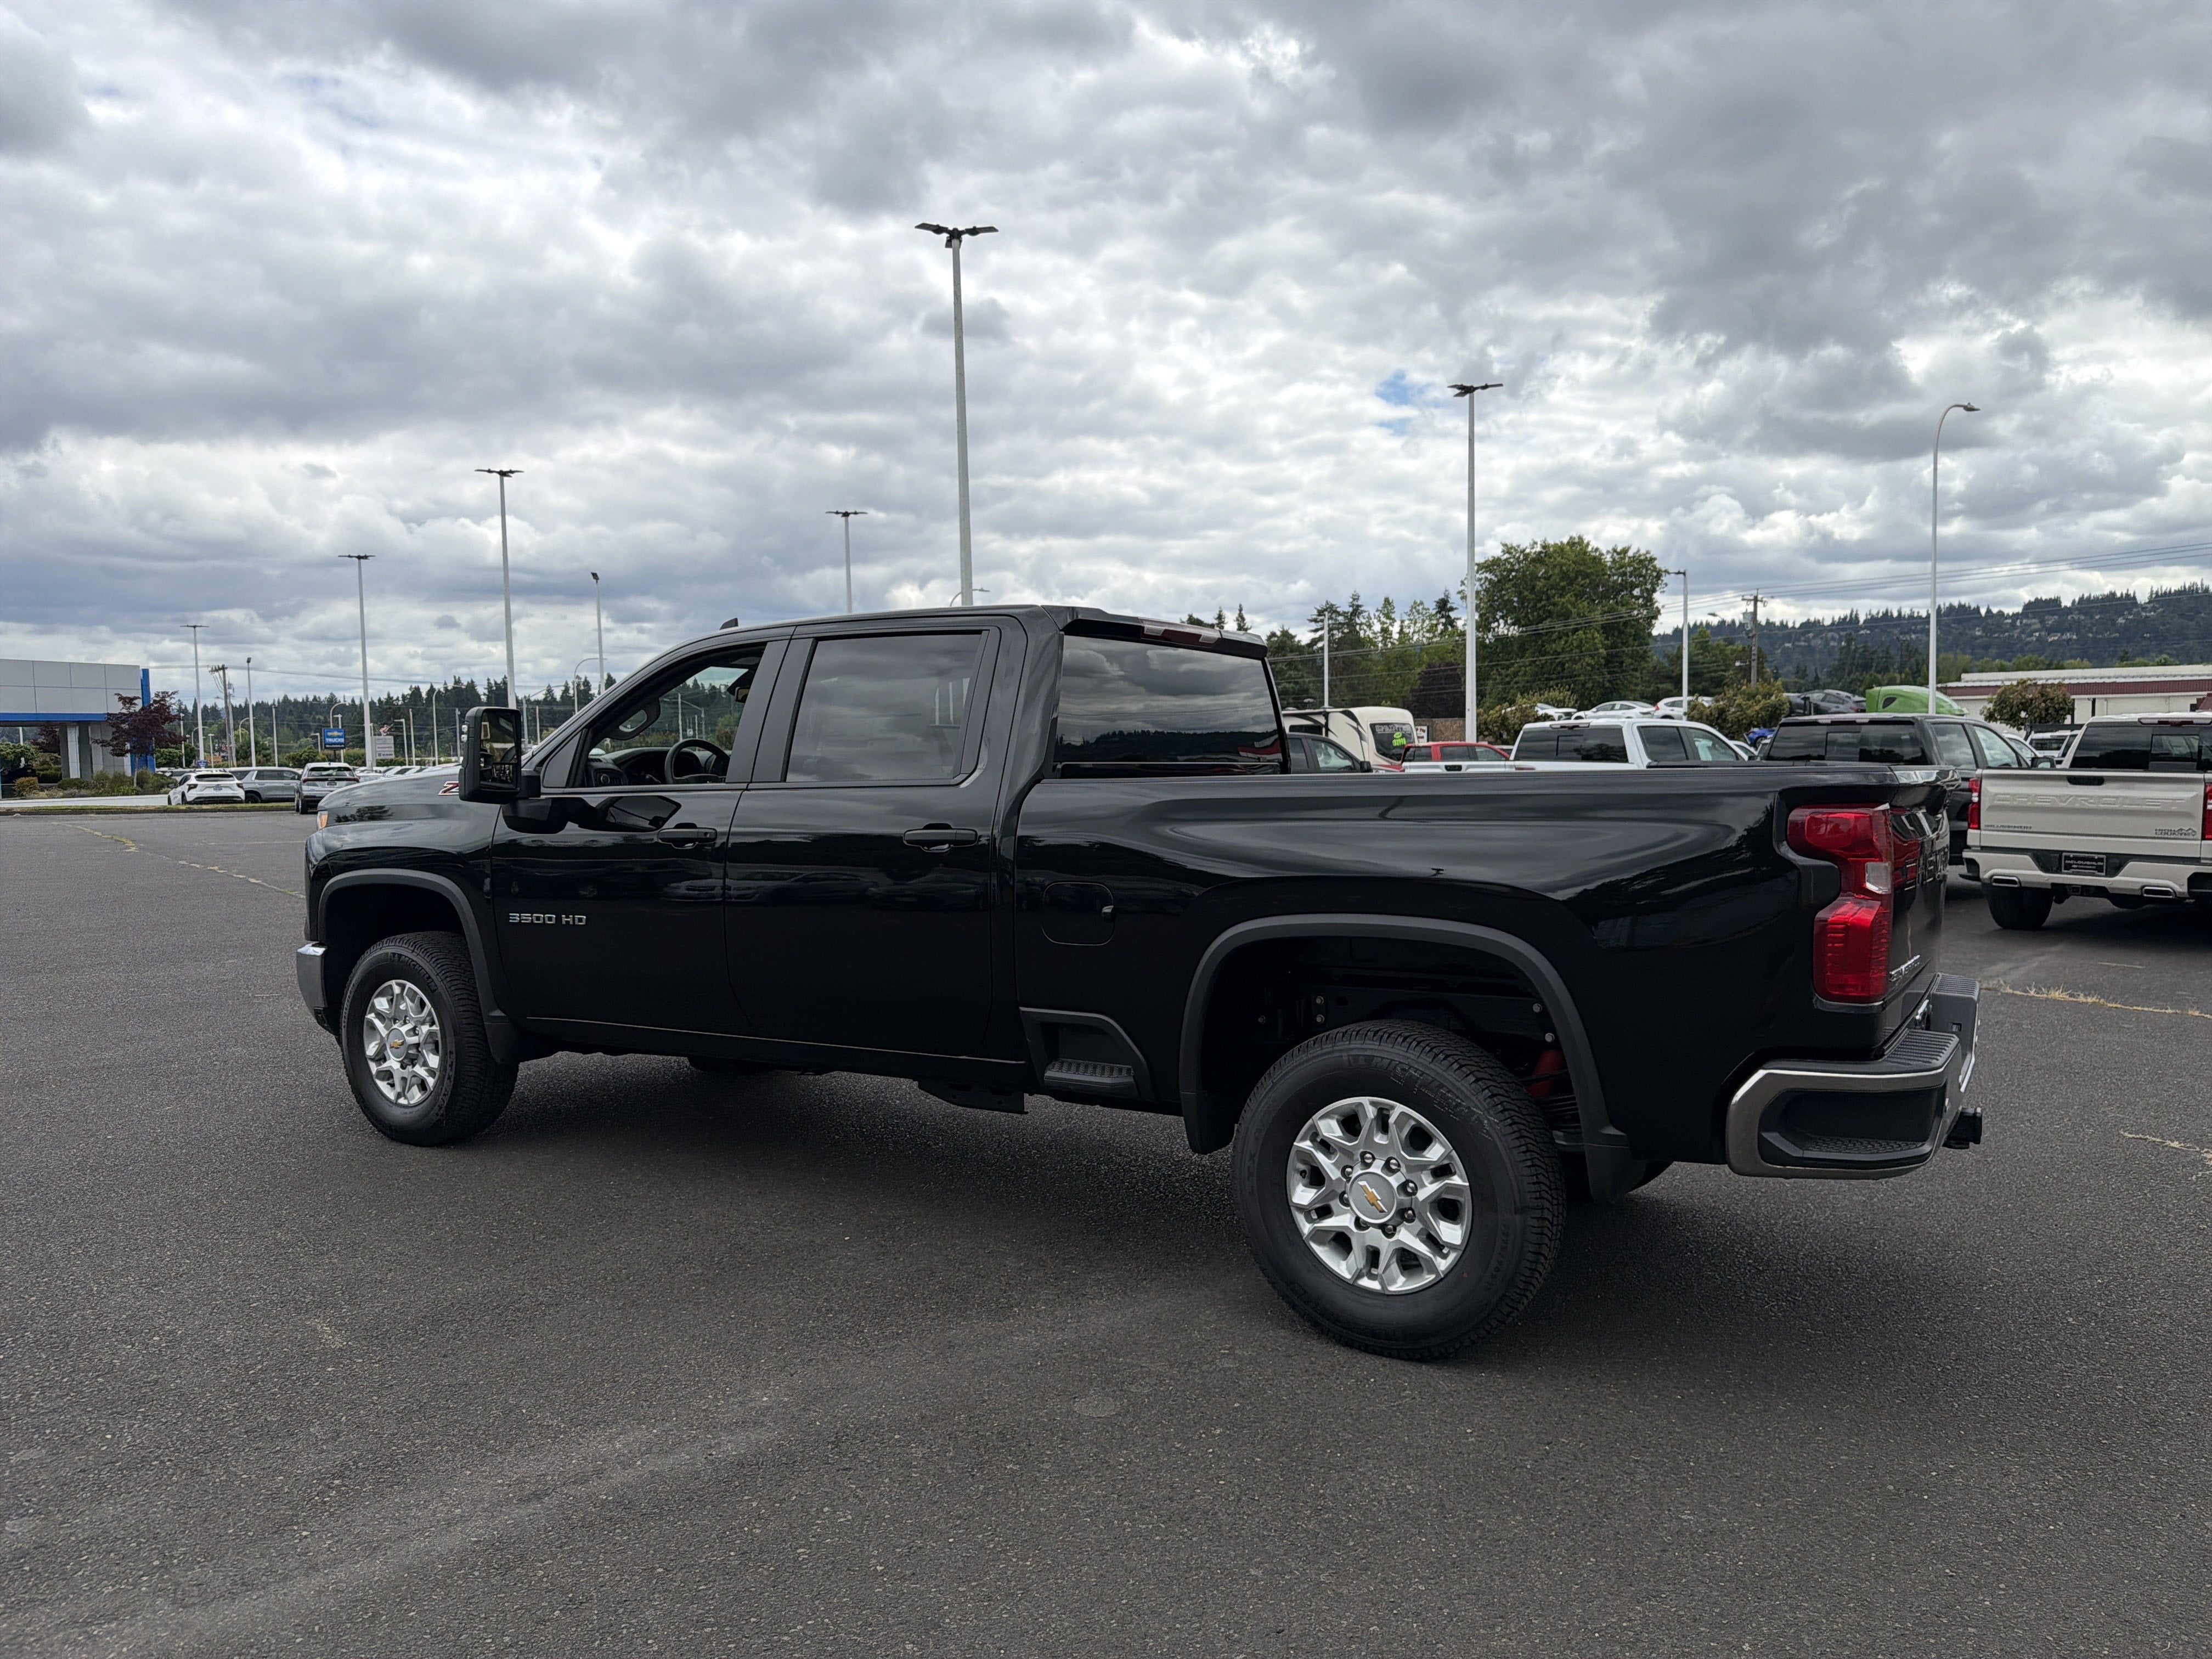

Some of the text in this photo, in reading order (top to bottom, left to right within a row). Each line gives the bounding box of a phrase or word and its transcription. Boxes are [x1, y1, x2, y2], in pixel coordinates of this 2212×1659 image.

[1995, 793, 2186, 810] CHEVROLET
[509, 913, 586, 925] 3500 HD
